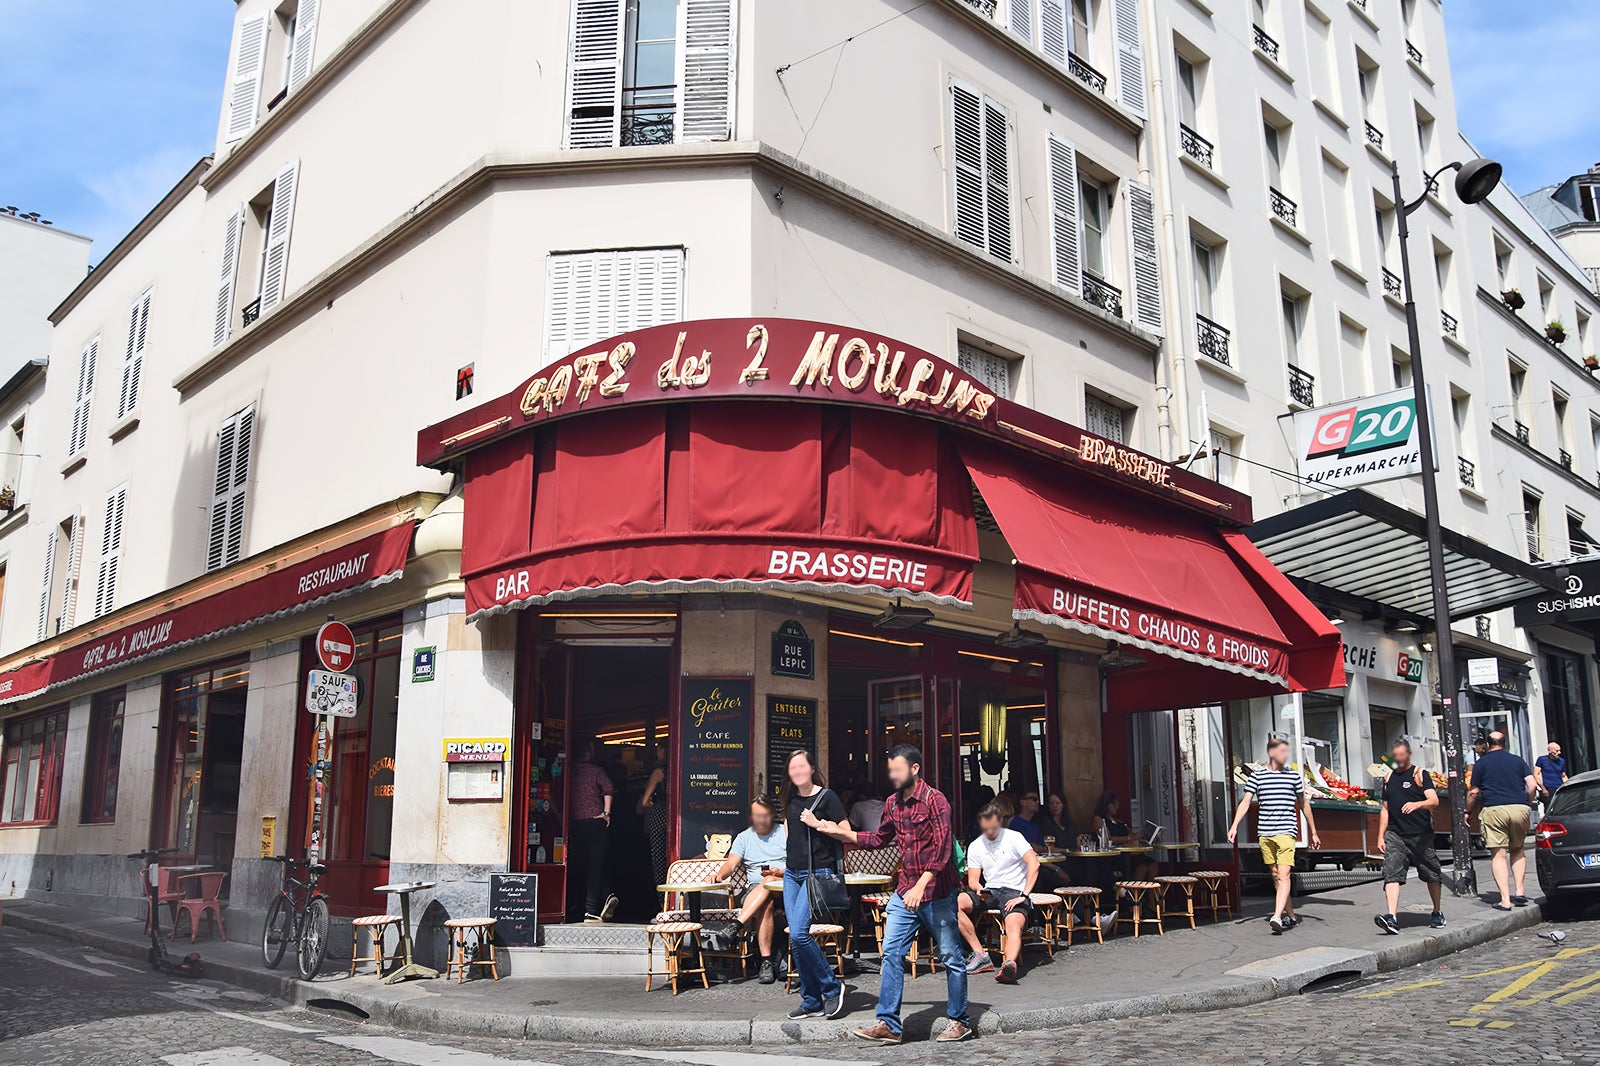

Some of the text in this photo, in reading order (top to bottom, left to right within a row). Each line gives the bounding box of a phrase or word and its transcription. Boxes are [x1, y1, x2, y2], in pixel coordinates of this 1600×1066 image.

[658, 331, 712, 389] des
[738, 324, 769, 386] 2
[789, 331, 996, 420] MOULINS
[1317, 405, 1411, 446] G20
[1080, 434, 1171, 488] BRASSERIE
[1306, 450, 1419, 484] SUPERMARCHÉ
[297, 553, 370, 594] RESTAURANT
[768, 550, 928, 587] BRASSERIE
[495, 570, 530, 601] BAR
[119, 636, 127, 658] 2
[128, 620, 173, 655] MOULINS
[1052, 588, 1270, 668] BUFFETS CHAUDS & FROIDS
[780, 656, 807, 670] LEPIC
[784, 645, 802, 657] RUE
[1399, 655, 1422, 678] G20
[321, 674, 347, 688] SAUF
[775, 703, 808, 715] ENTREES
[447, 742, 507, 754] RICARD
[705, 731, 730, 740] CAFÉ
[780, 727, 803, 738] PLATS
